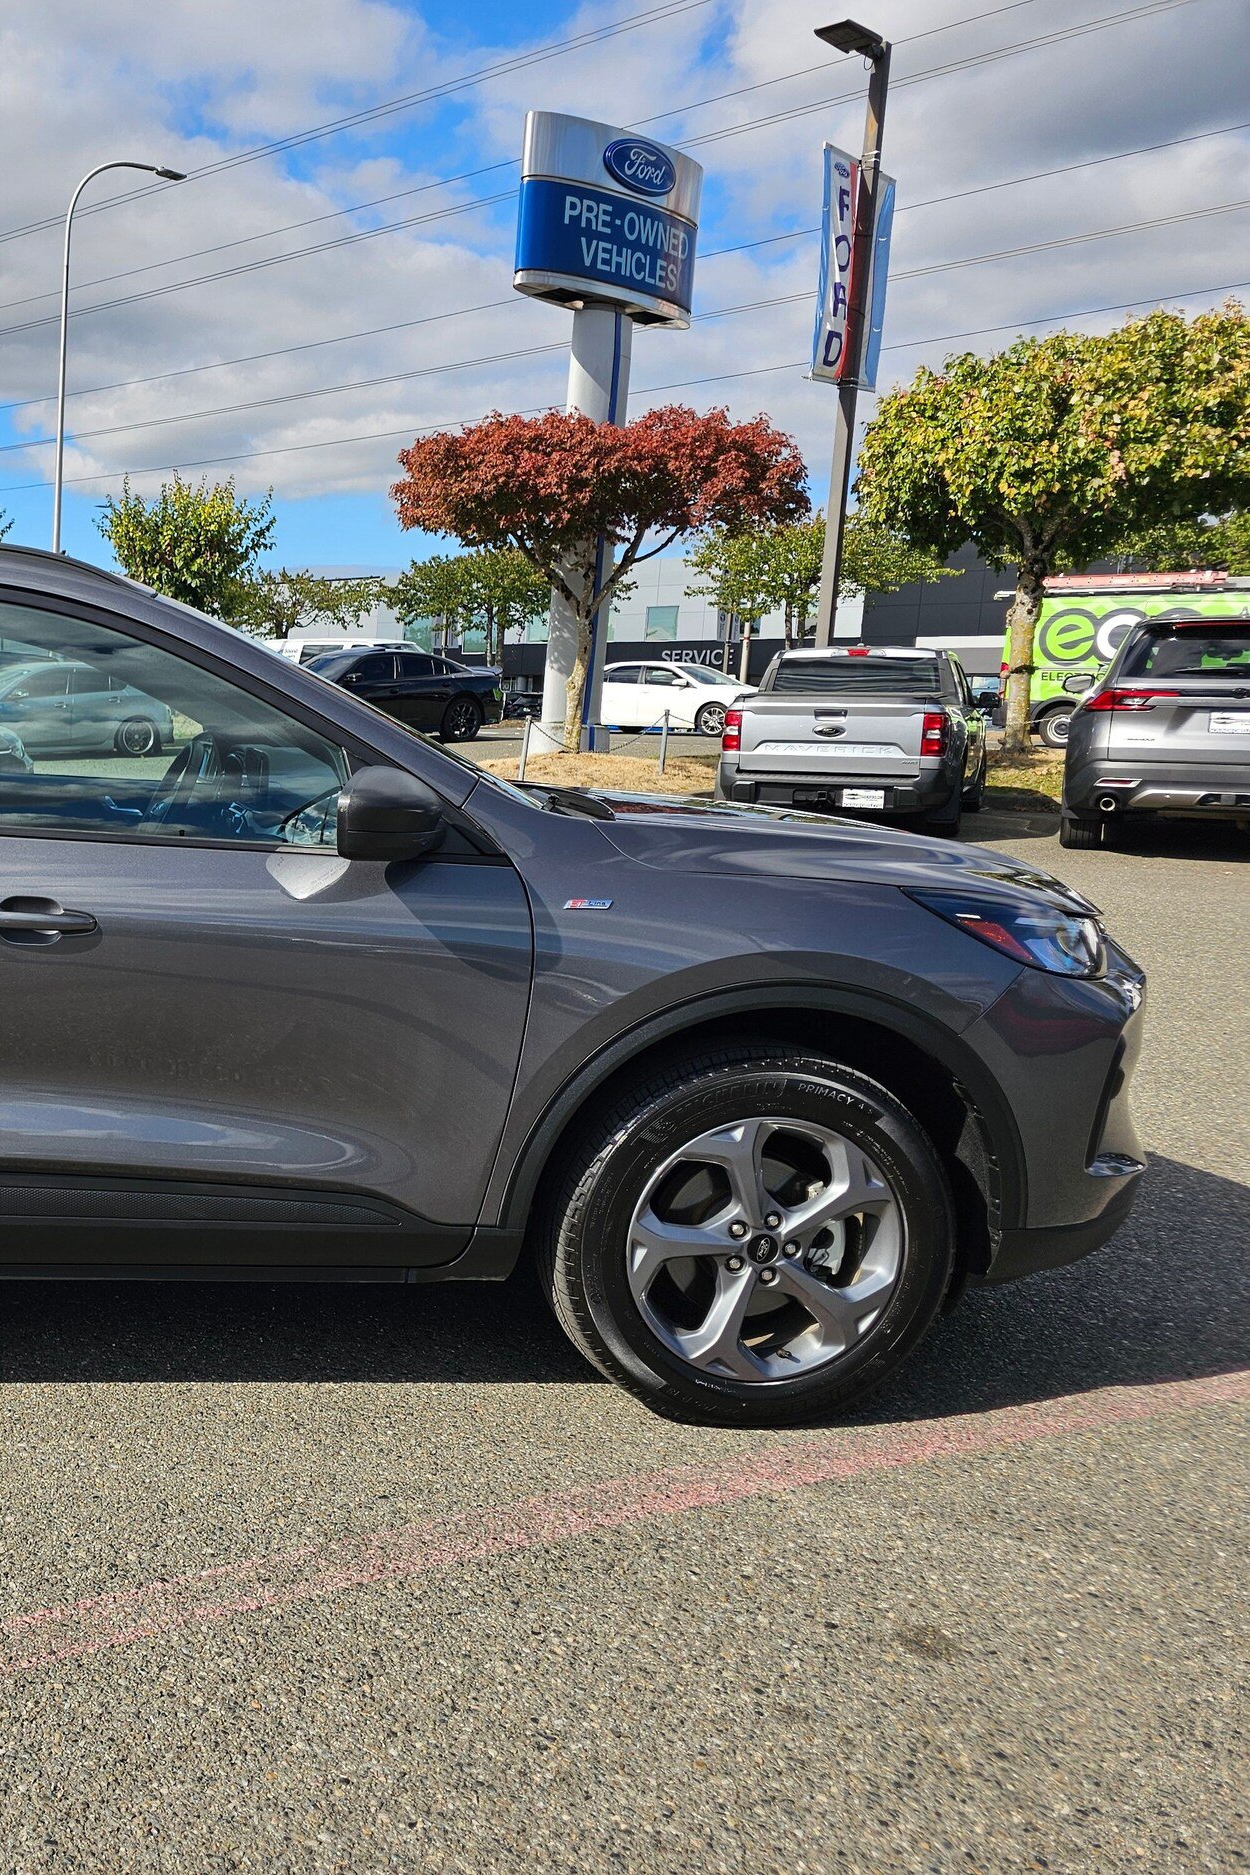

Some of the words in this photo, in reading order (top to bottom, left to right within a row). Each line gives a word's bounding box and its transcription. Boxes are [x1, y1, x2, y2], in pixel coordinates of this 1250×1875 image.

[625, 148, 666, 185] Ford
[564, 195, 689, 260] PRE-OWNED
[581, 237, 677, 292] VEHICLES
[661, 649, 735, 665] SERVICE
[764, 743, 894, 754] MAVERICK
[797, 1083, 855, 1105] PRIMACY
